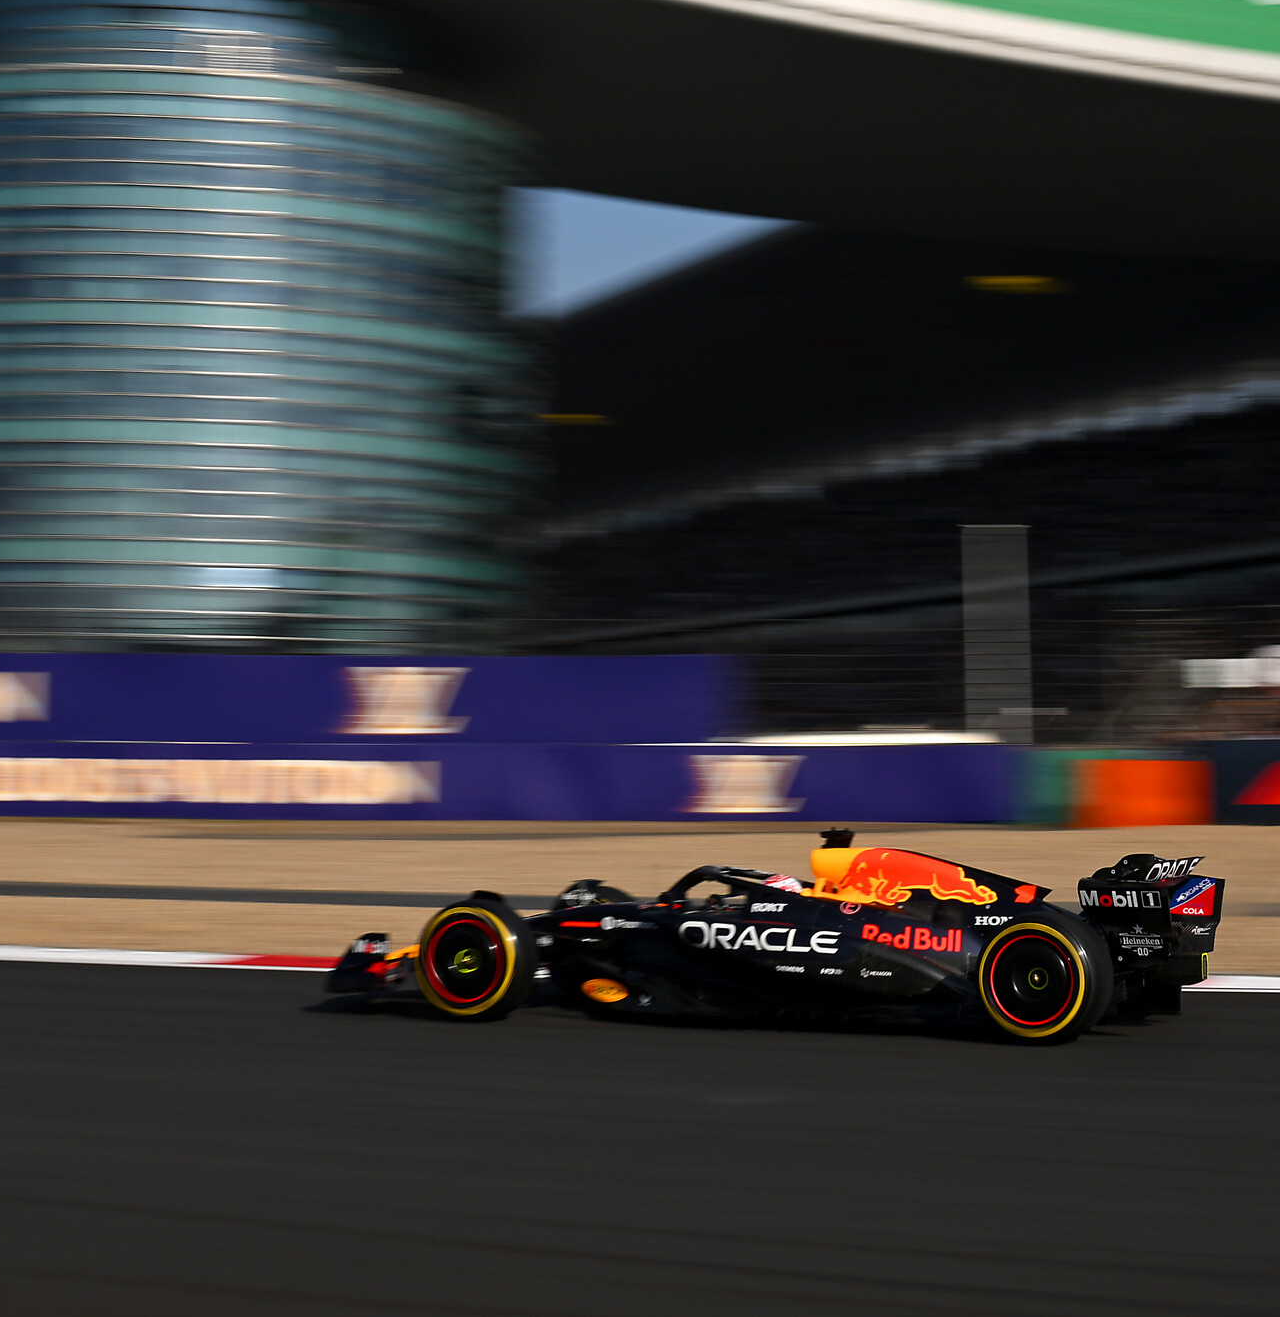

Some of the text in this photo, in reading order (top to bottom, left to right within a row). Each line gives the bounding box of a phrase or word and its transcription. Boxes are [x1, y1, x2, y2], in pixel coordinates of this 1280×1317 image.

[1144, 858, 1200, 881] ORACLE
[1079, 890, 1139, 908] Mobil
[1182, 907, 1205, 915] COLA
[678, 920, 842, 955] ORACLE
[861, 923, 963, 953] Red Bull
[1122, 936, 1161, 946] Heineken
